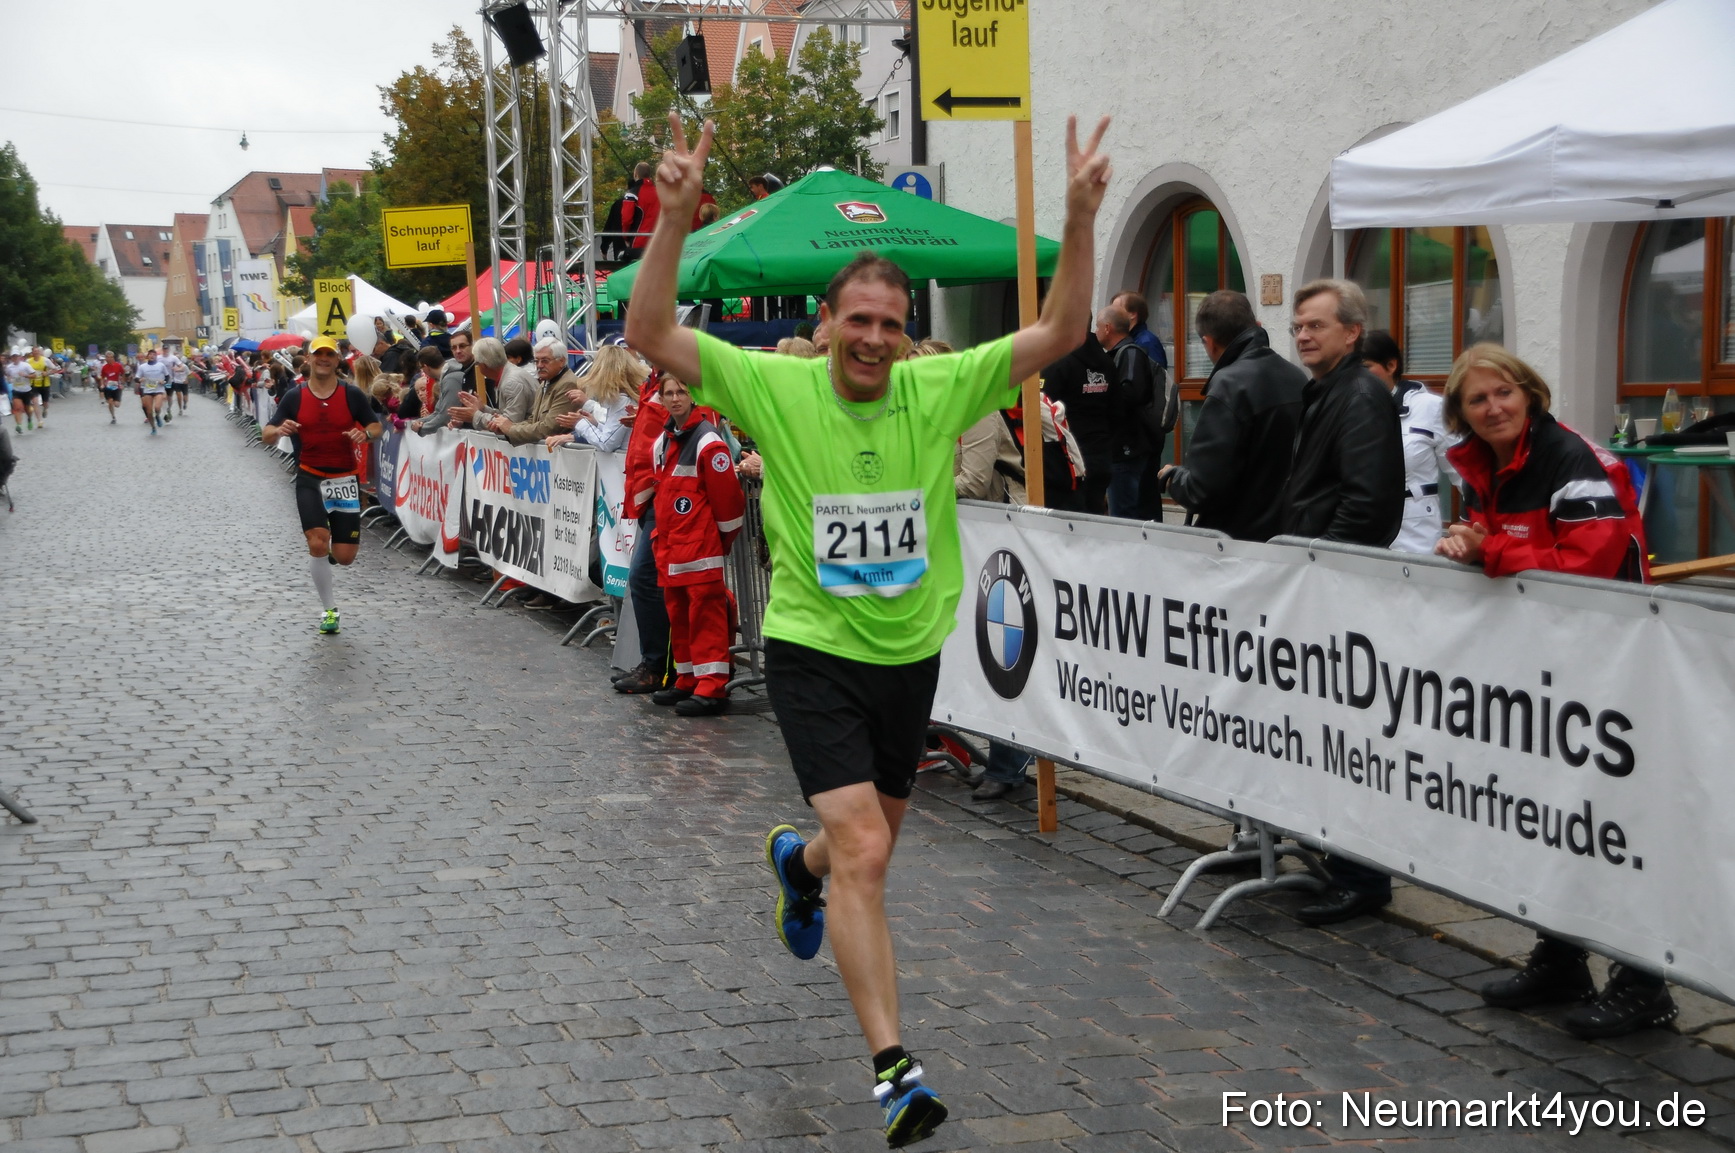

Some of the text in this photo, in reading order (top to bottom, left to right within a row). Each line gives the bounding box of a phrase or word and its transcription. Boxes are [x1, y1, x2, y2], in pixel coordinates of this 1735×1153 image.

[952, 20, 998, 47] lauf
[390, 225, 464, 237] Schnupper-
[824, 227, 930, 238] Neumarkter
[416, 239, 441, 251] lauf
[809, 236, 959, 250] Lammsbräu
[319, 282, 352, 293] Block
[326, 297, 349, 326] A
[228, 315, 236, 327] B
[483, 448, 551, 504] INTESPORT
[326, 485, 357, 500] 2609
[816, 502, 907, 516] PARTL Neumarkt
[827, 517, 918, 560] 2114
[606, 574, 628, 588] Servic
[853, 568, 894, 583] Armin
[1052, 578, 1635, 778] BMW EfficientDynamics
[1056, 659, 1643, 870] Weniger Verbrauch. Mehr Fahrfreude.
